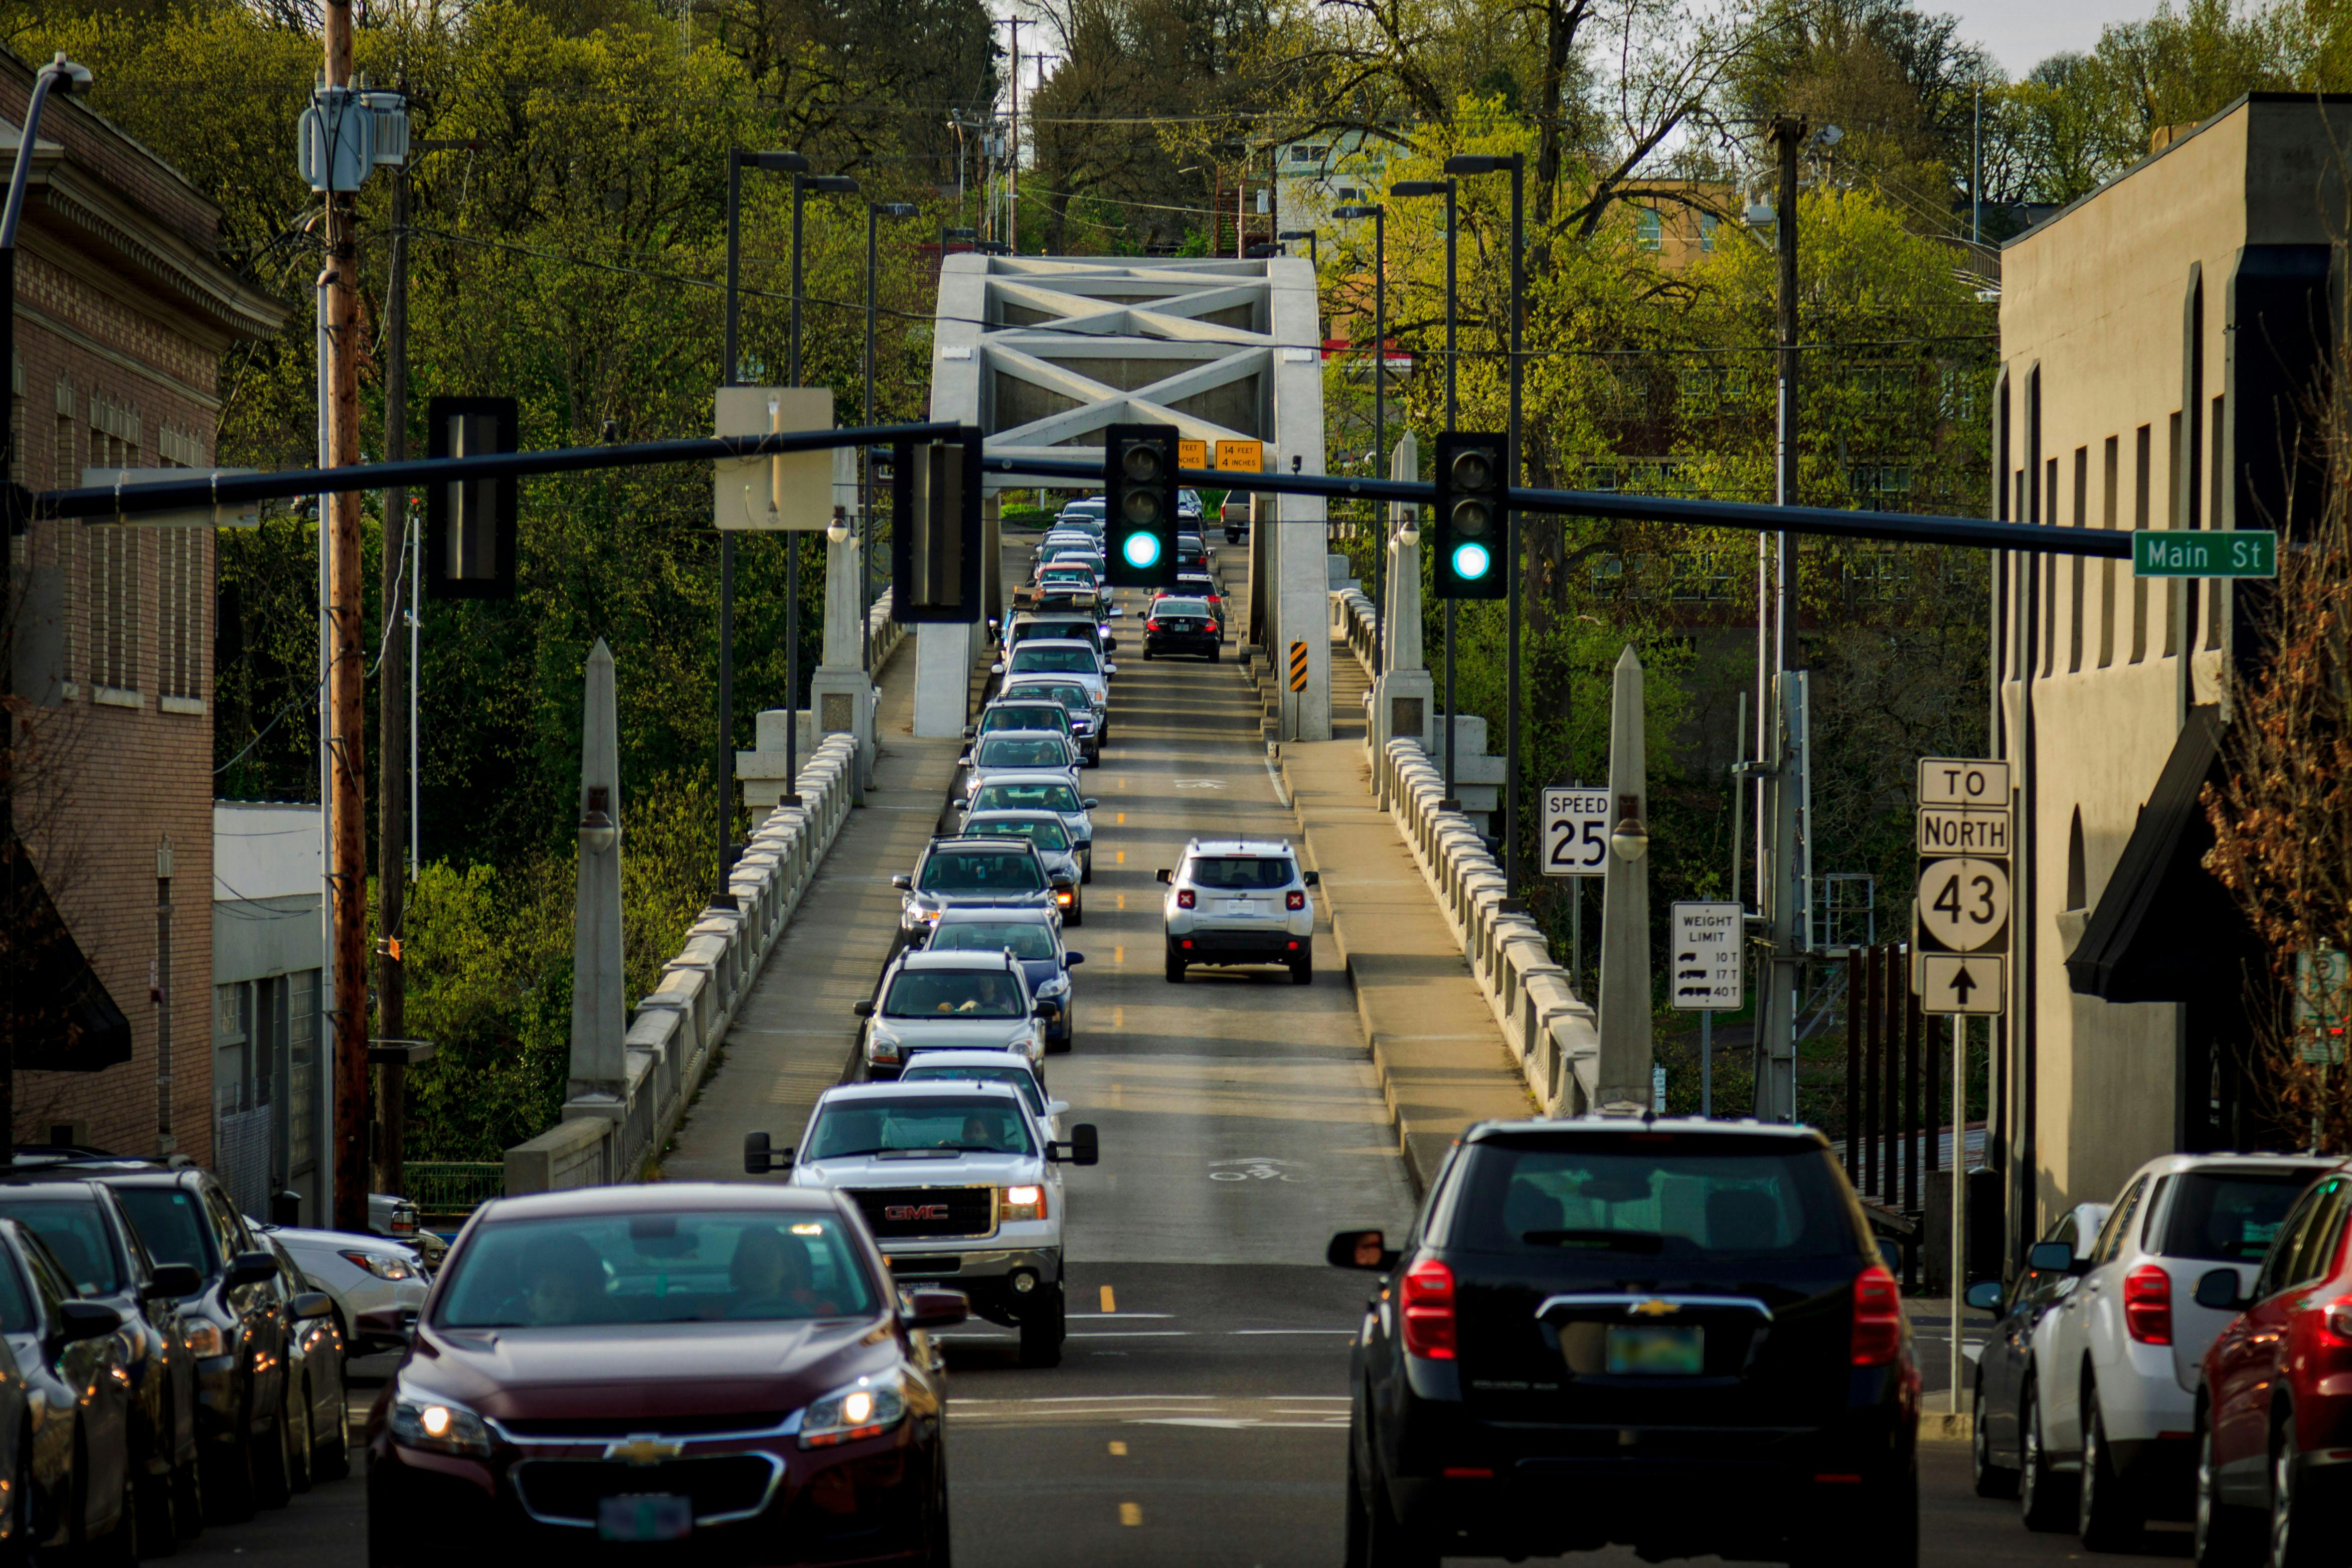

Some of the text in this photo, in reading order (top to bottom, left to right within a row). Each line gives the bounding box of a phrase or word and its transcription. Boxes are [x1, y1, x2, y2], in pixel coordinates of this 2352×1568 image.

[1225, 446, 1234, 455] 14
[2148, 540, 2261, 568] Main St
[1943, 770, 1986, 796] TO
[1550, 797, 1608, 813] SPEED
[1925, 816, 2005, 847] NORTH
[1550, 819, 1606, 866] 25
[1933, 874, 1995, 925] 43
[1684, 916, 1733, 926] WEIGHT
[1690, 932, 1725, 942] LIMIT
[1716, 953, 1737, 962] 10 T
[1717, 970, 1737, 979] 17 T
[1714, 987, 1737, 996] 40 T
[884, 1203, 949, 1221] GMC
